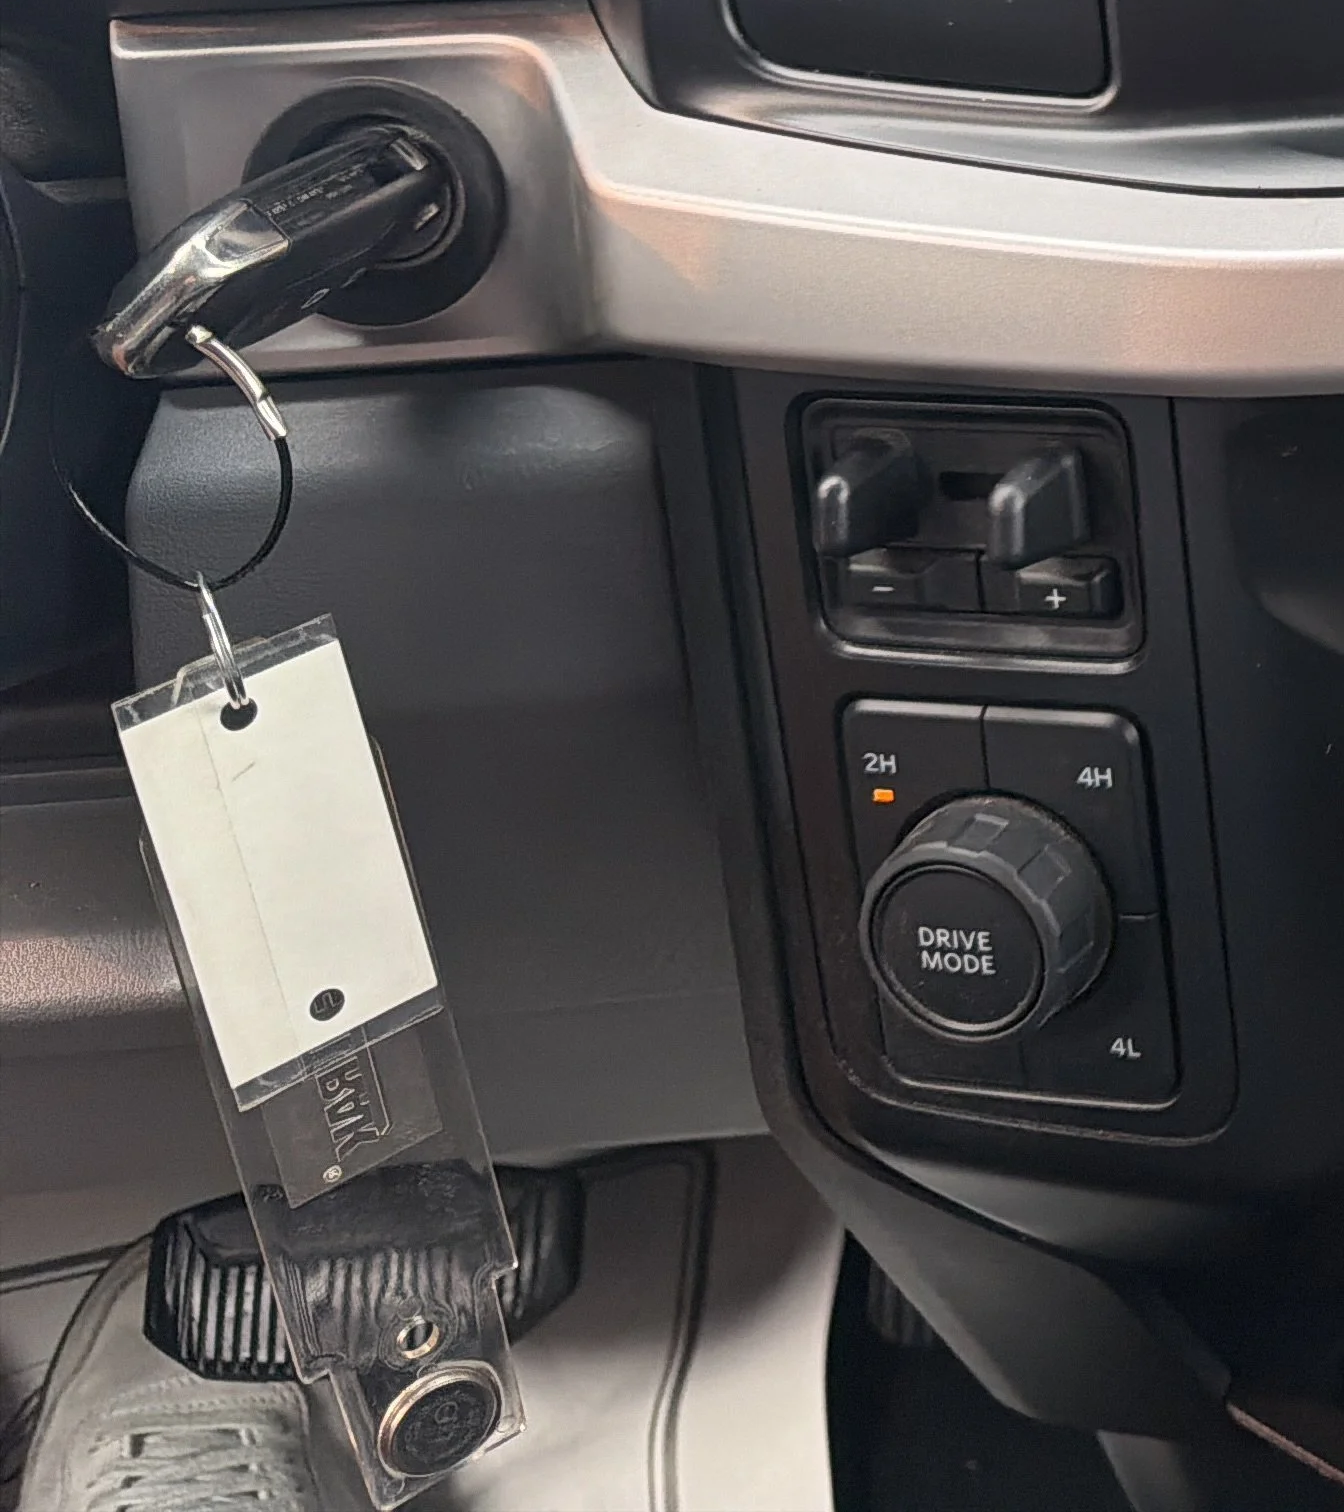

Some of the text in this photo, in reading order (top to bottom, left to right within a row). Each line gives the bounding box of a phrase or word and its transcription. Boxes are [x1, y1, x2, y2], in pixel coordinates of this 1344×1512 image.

[863, 753, 897, 776] 2H
[1077, 767, 1113, 789] 4H
[918, 925, 993, 953] DRIVE
[921, 950, 996, 976] MODE
[1111, 1037, 1141, 1060] 4L
